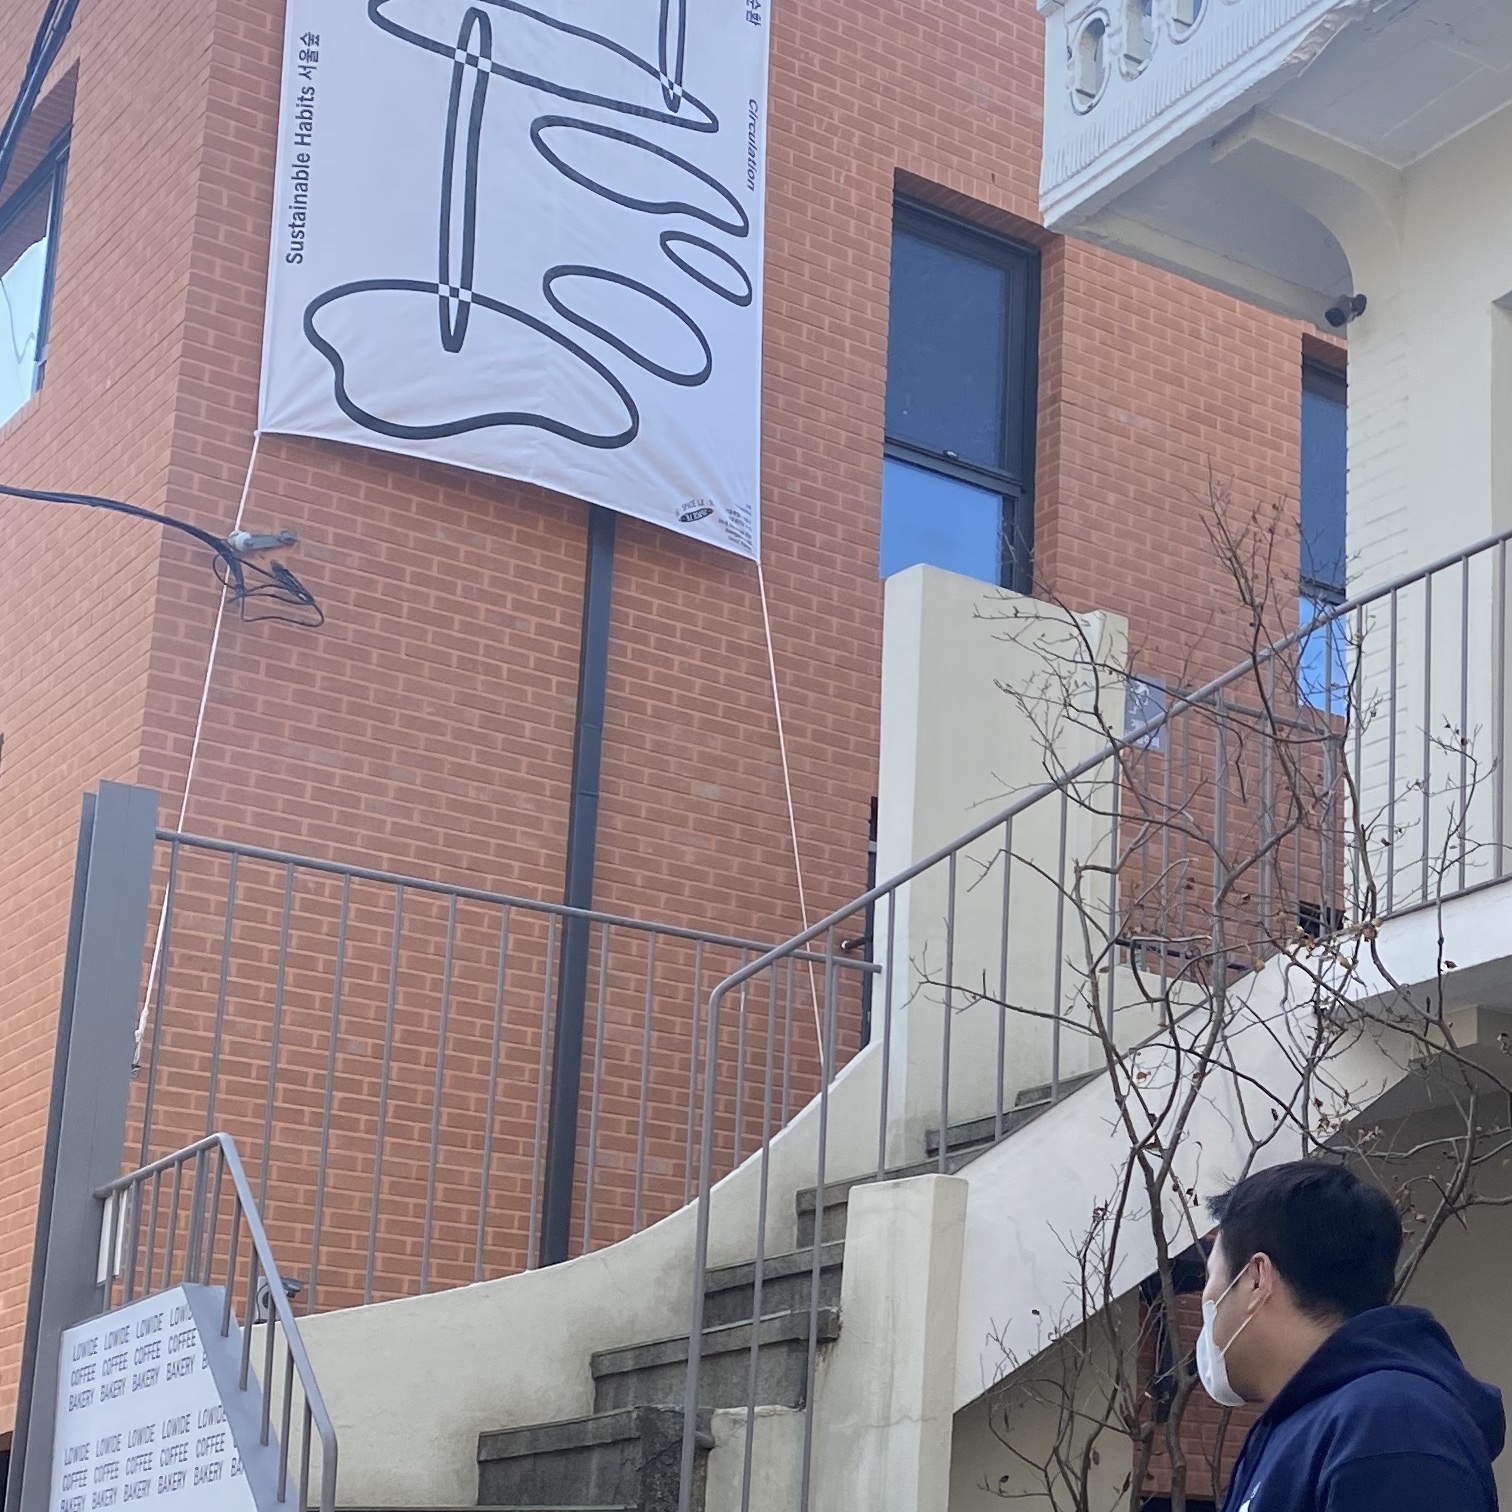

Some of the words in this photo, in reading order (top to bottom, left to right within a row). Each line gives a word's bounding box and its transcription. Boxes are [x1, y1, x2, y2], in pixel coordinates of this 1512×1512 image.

[298, 31, 320, 81] 서울숲
[294, 85, 316, 147] Habits
[746, 98, 759, 191] Circulation
[286, 152, 311, 265] Sustainable
[193, 1460, 223, 1485] BAKERY
[195, 1432, 225, 1457] COFFEE
